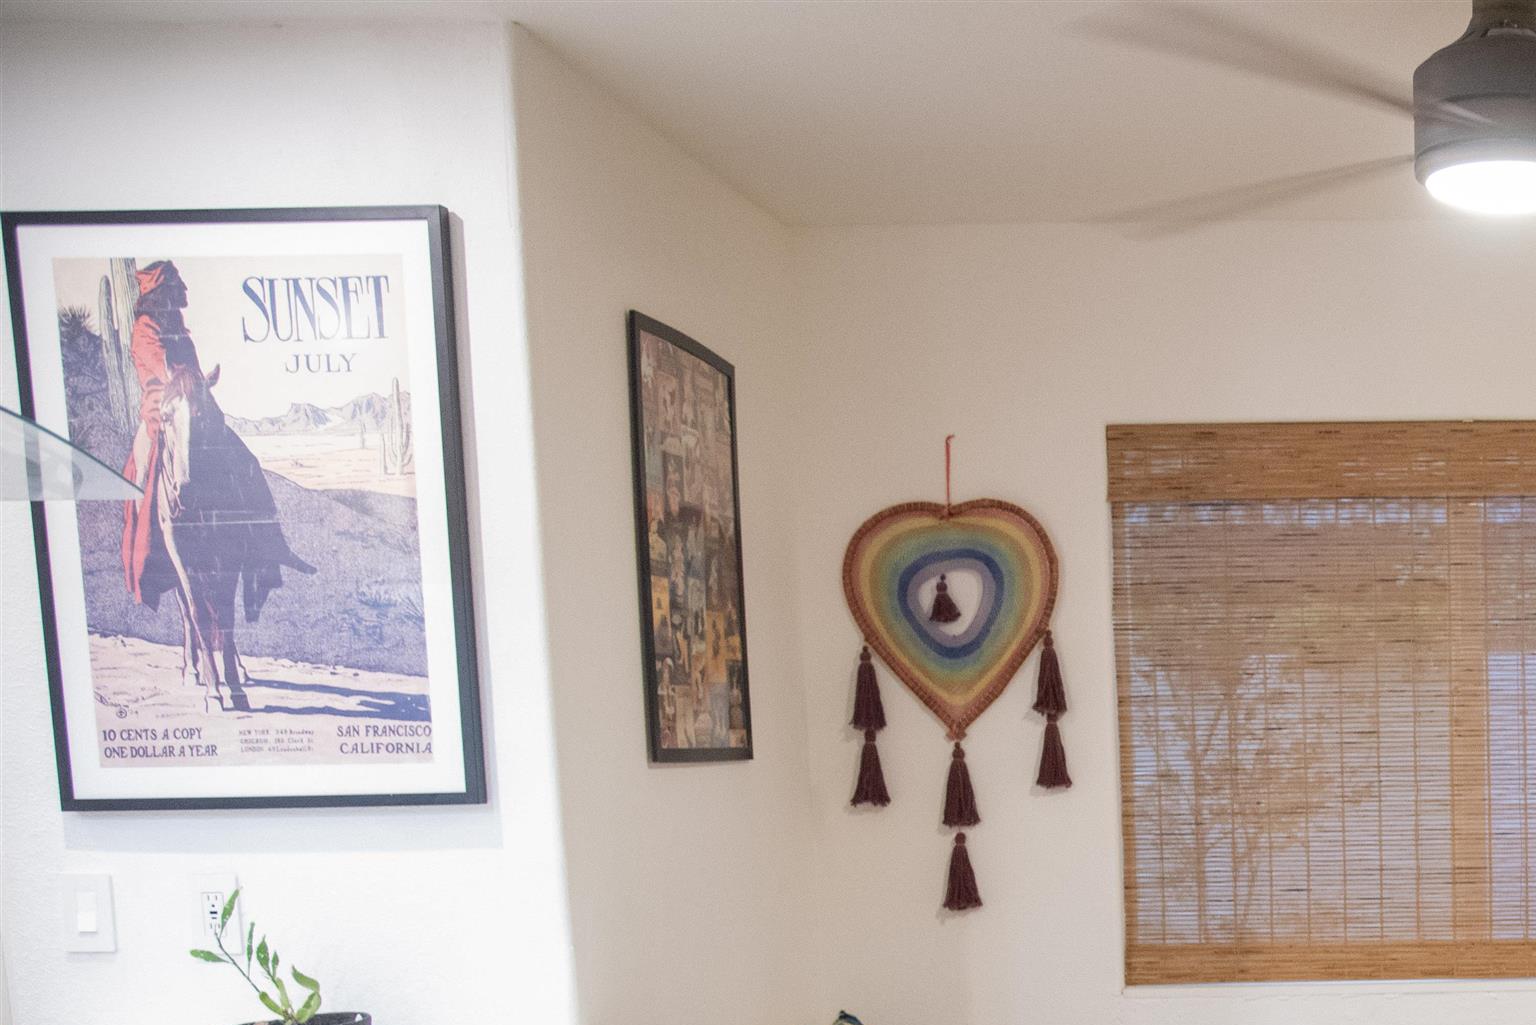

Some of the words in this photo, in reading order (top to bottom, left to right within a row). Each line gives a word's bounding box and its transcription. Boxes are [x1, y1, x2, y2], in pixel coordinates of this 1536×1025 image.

[241, 274, 390, 343] SUNSET
[285, 352, 358, 374] JULY
[102, 729, 117, 742] 10
[120, 728, 158, 742] CENTS
[161, 728, 171, 741] A
[173, 727, 203, 741] COPY
[337, 724, 360, 737] SAN
[365, 724, 432, 738] FRANCISCO
[104, 746, 128, 759] ONE
[130, 746, 177, 758] DOLLAR
[178, 746, 187, 758] A
[188, 744, 219, 757] YEAR
[340, 742, 433, 754] CALIFORNIA
